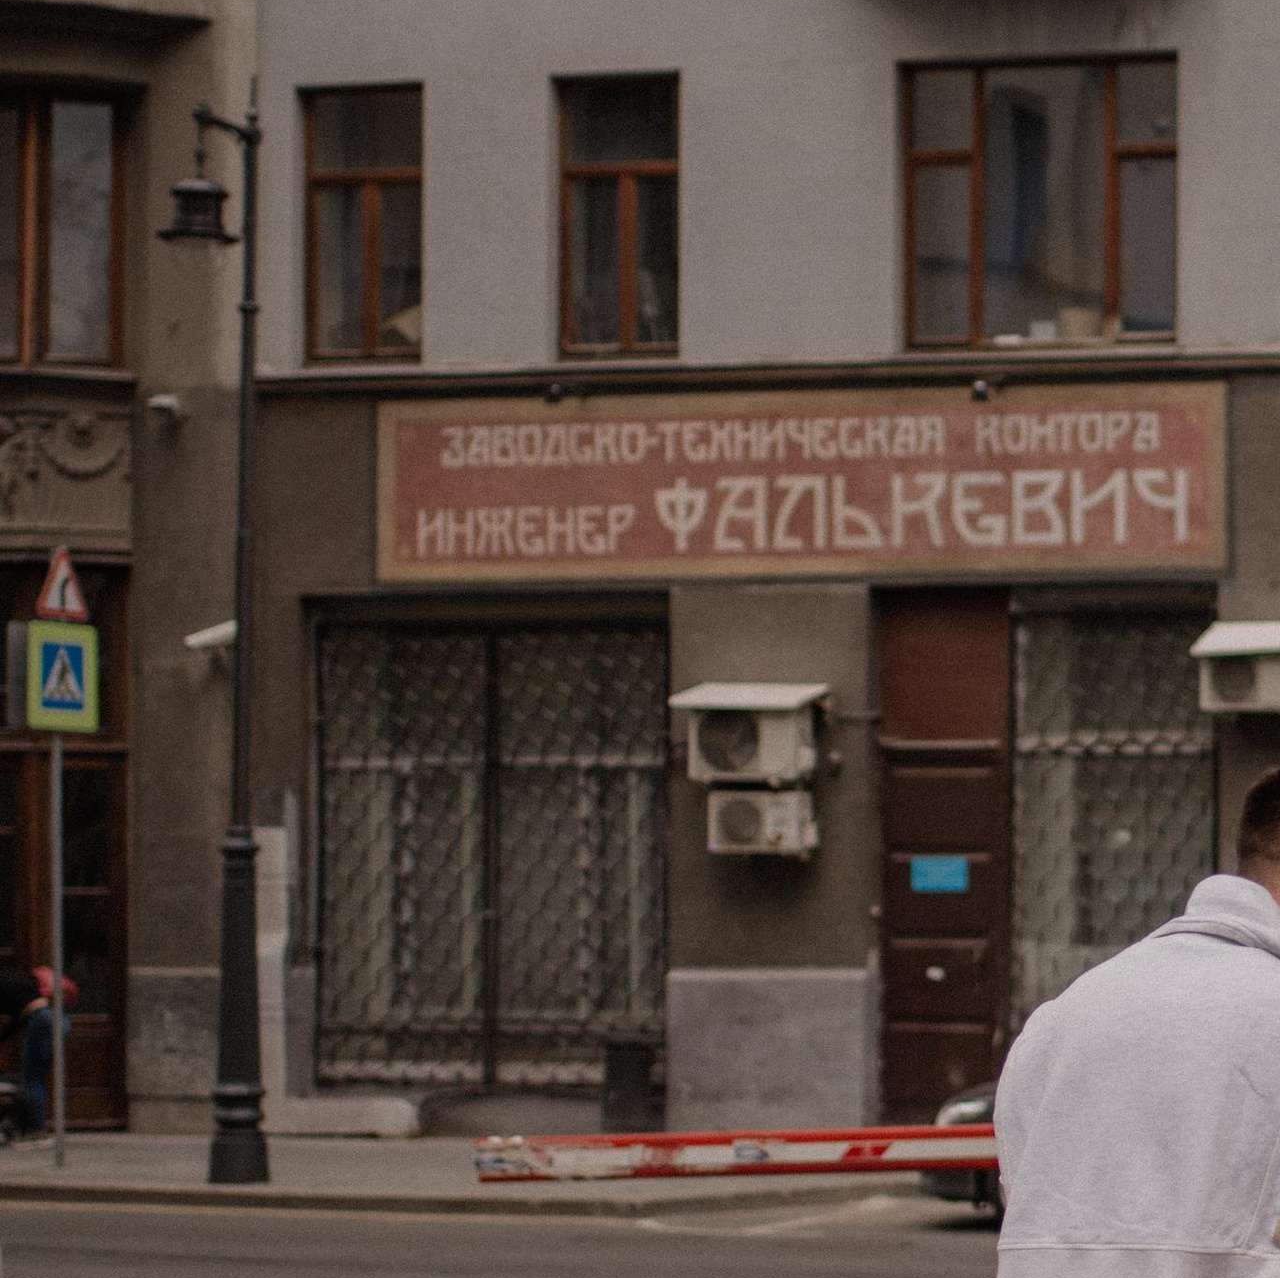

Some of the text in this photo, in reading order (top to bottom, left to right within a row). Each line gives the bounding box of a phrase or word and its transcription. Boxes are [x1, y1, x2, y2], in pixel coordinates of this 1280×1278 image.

[440, 411, 1162, 469] ЗАВОДСКО-ТЕХНИЧЕСКАЯ КОНТОРА
[416, 467, 1191, 558] ИНЖЕНЕР ФАЛЬКЕВИЧ
